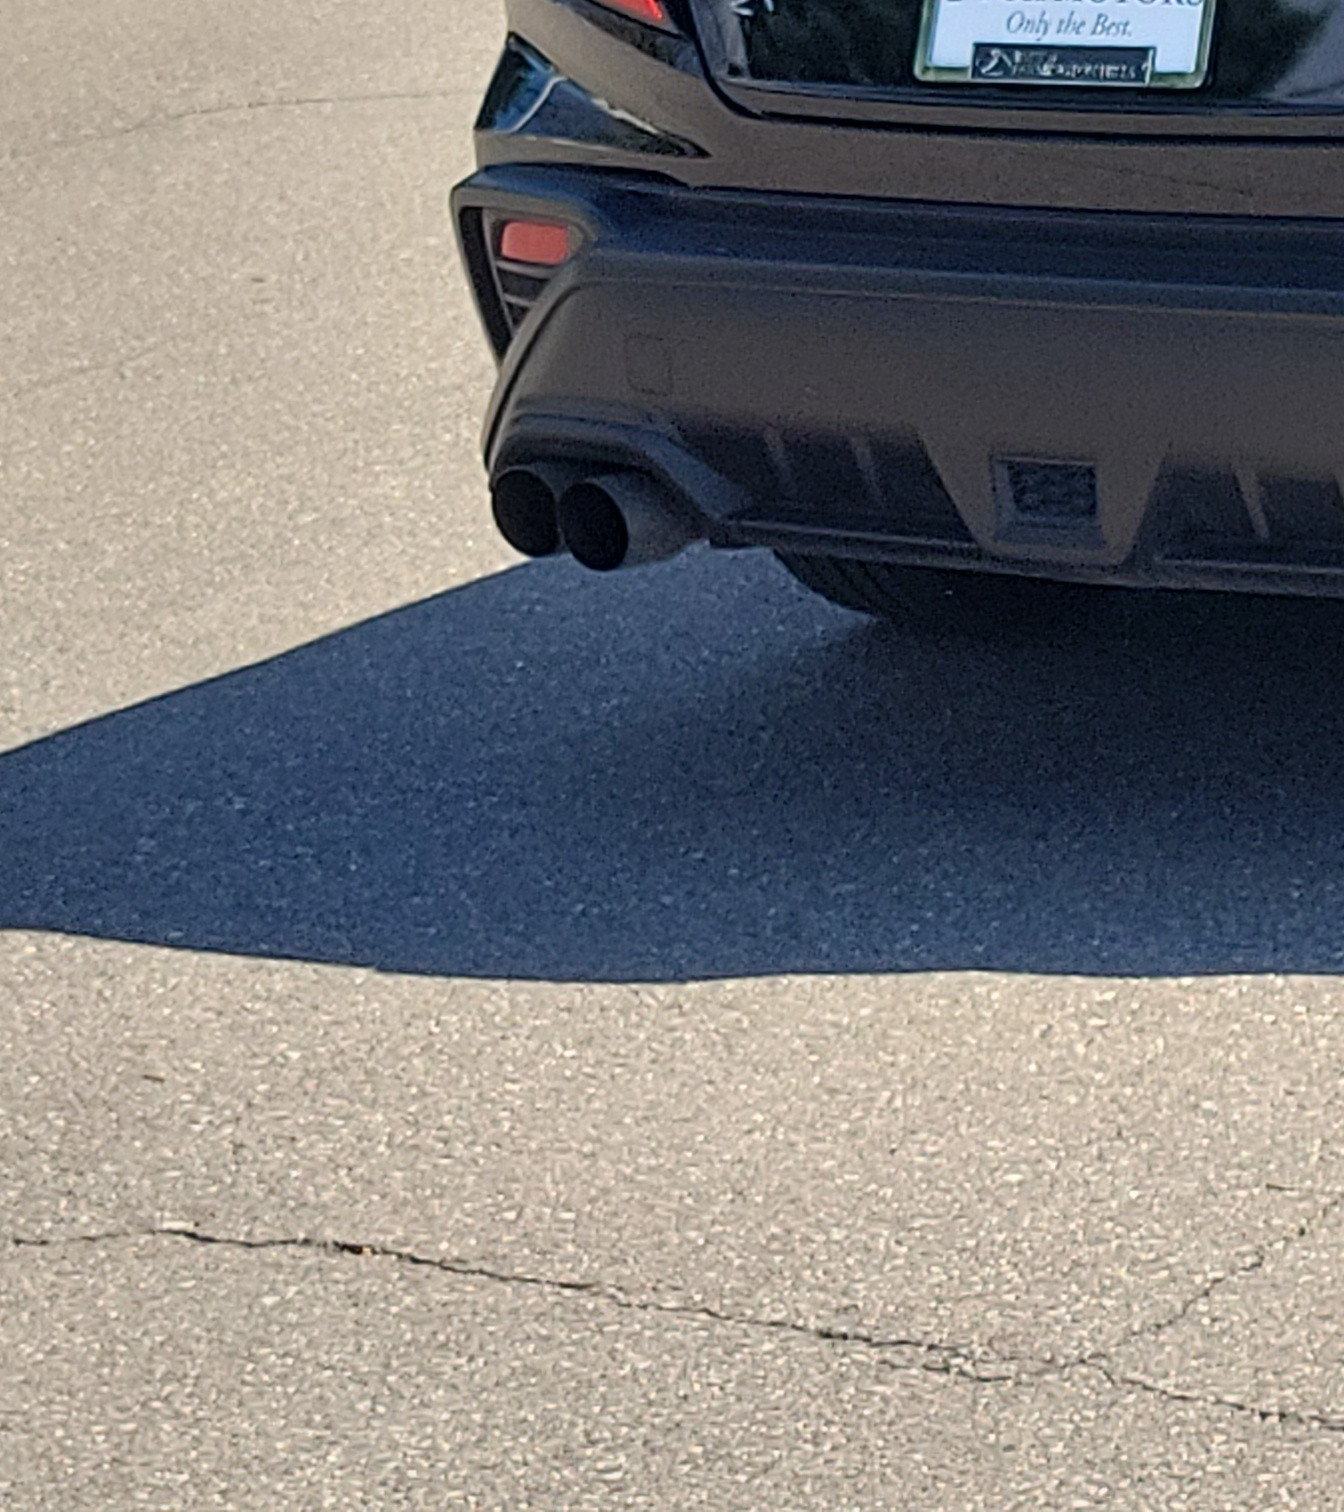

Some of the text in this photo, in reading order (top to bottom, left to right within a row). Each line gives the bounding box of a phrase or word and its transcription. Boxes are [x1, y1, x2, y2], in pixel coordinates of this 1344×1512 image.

[1006, 10, 1133, 40] Only the Best.
